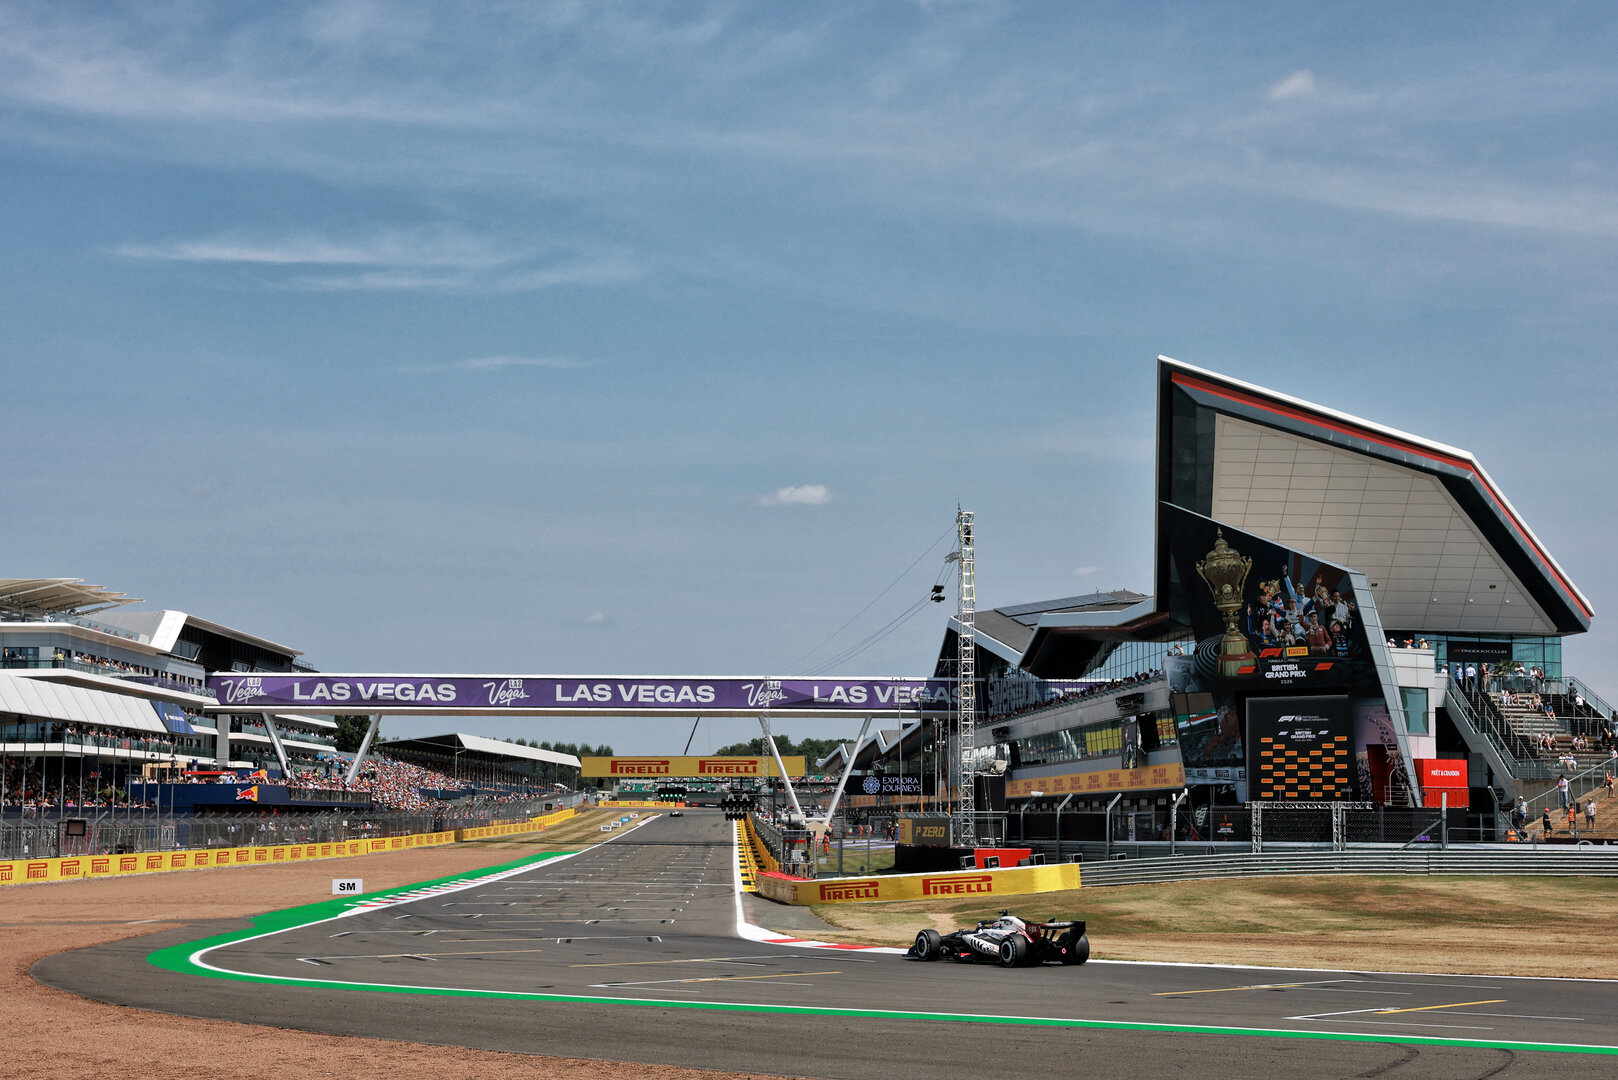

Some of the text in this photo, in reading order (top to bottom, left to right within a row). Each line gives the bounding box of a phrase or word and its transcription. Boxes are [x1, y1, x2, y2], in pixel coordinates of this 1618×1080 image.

[248, 678, 260, 686] LAS
[509, 680, 522, 688] LAS
[220, 679, 267, 704] Vegas
[294, 682, 456, 701] LAS VEGAS
[483, 680, 530, 706] Vegas
[556, 684, 715, 703] LAS VEGAS
[742, 683, 788, 707] Vegas
[813, 685, 867, 703] LAS
[611, 760, 670, 774] PIRELLI
[699, 760, 758, 774] PIRELLI
[916, 826, 921, 836] P
[922, 826, 945, 837] ZERO
[60, 860, 80, 876] PIRELLI
[92, 859, 109, 873] PIRELLI
[120, 857, 137, 871] PIRELLI
[146, 855, 162, 869] PIRELLI
[172, 854, 187, 867] PIRELLI
[0, 865, 13, 881] ELLI
[27, 863, 48, 879] PIRELLI
[339, 883, 356, 891] SM
[819, 881, 879, 900] PIRELLI
[922, 875, 992, 895] PIRELLI
